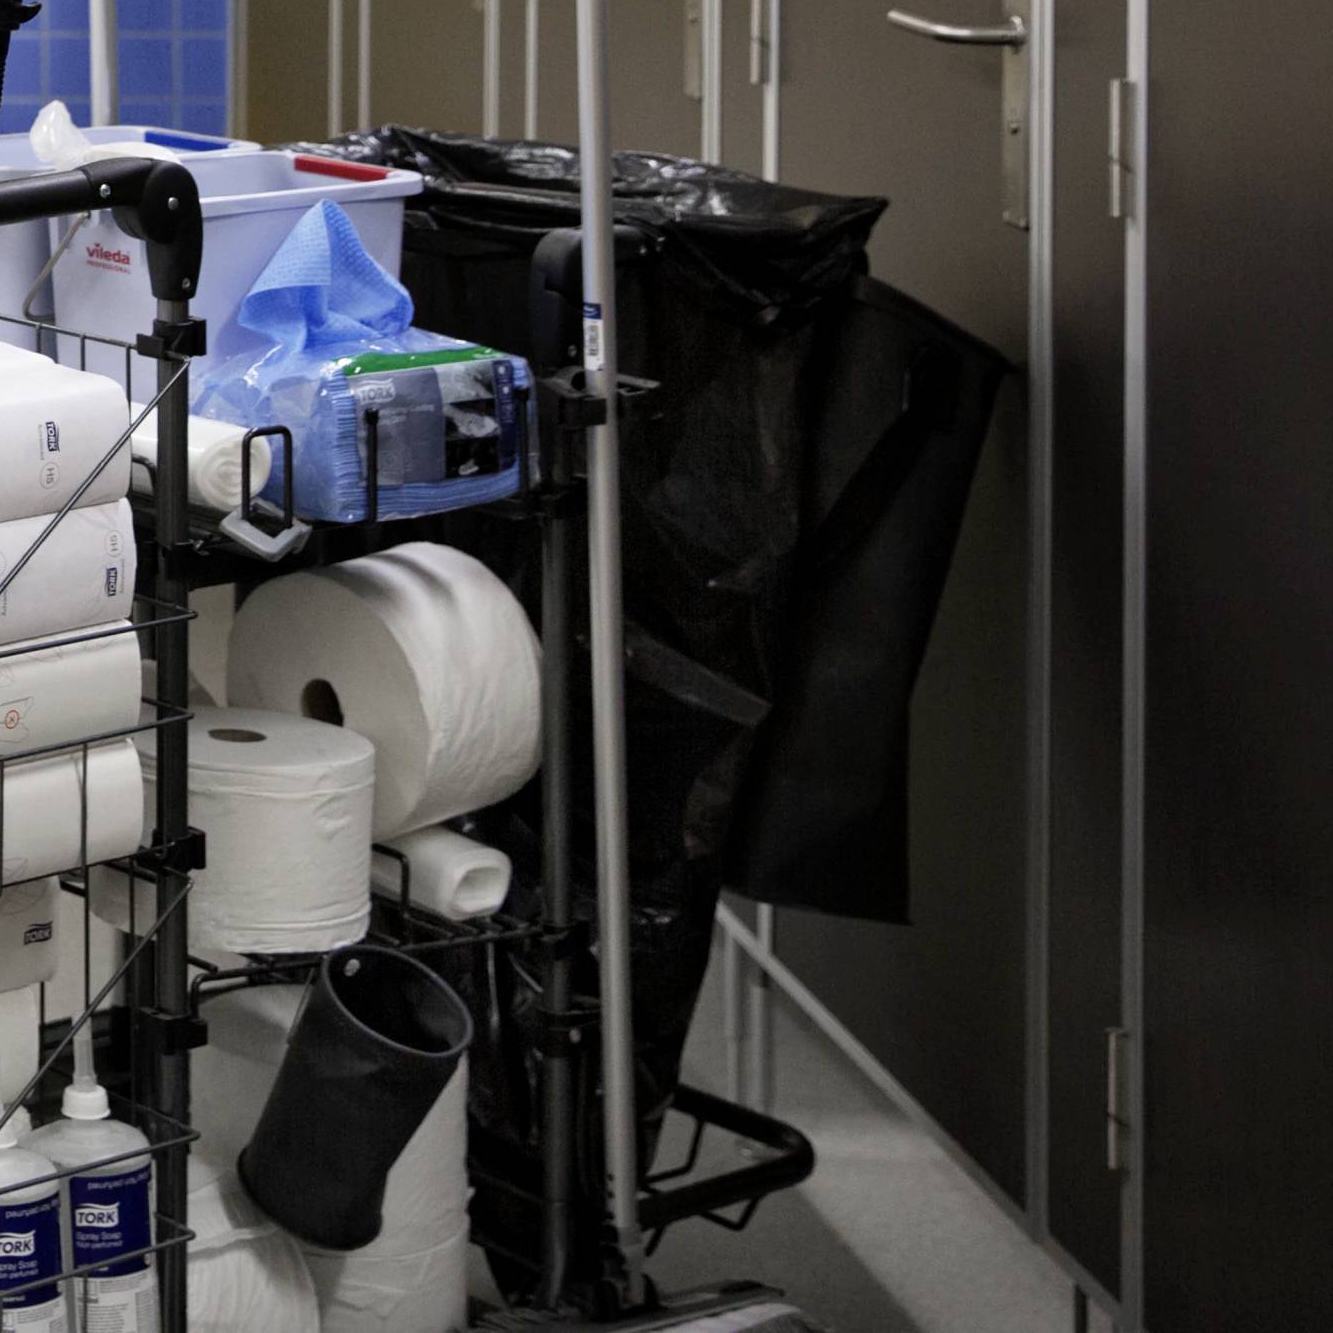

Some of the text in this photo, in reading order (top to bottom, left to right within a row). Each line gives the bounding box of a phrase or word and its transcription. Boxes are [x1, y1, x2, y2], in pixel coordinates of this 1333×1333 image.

[86, 243, 131, 265] vileda
[46, 422, 57, 451] TORK
[25, 928, 51, 943] TORK
[77, 1211, 116, 1225] TORK
